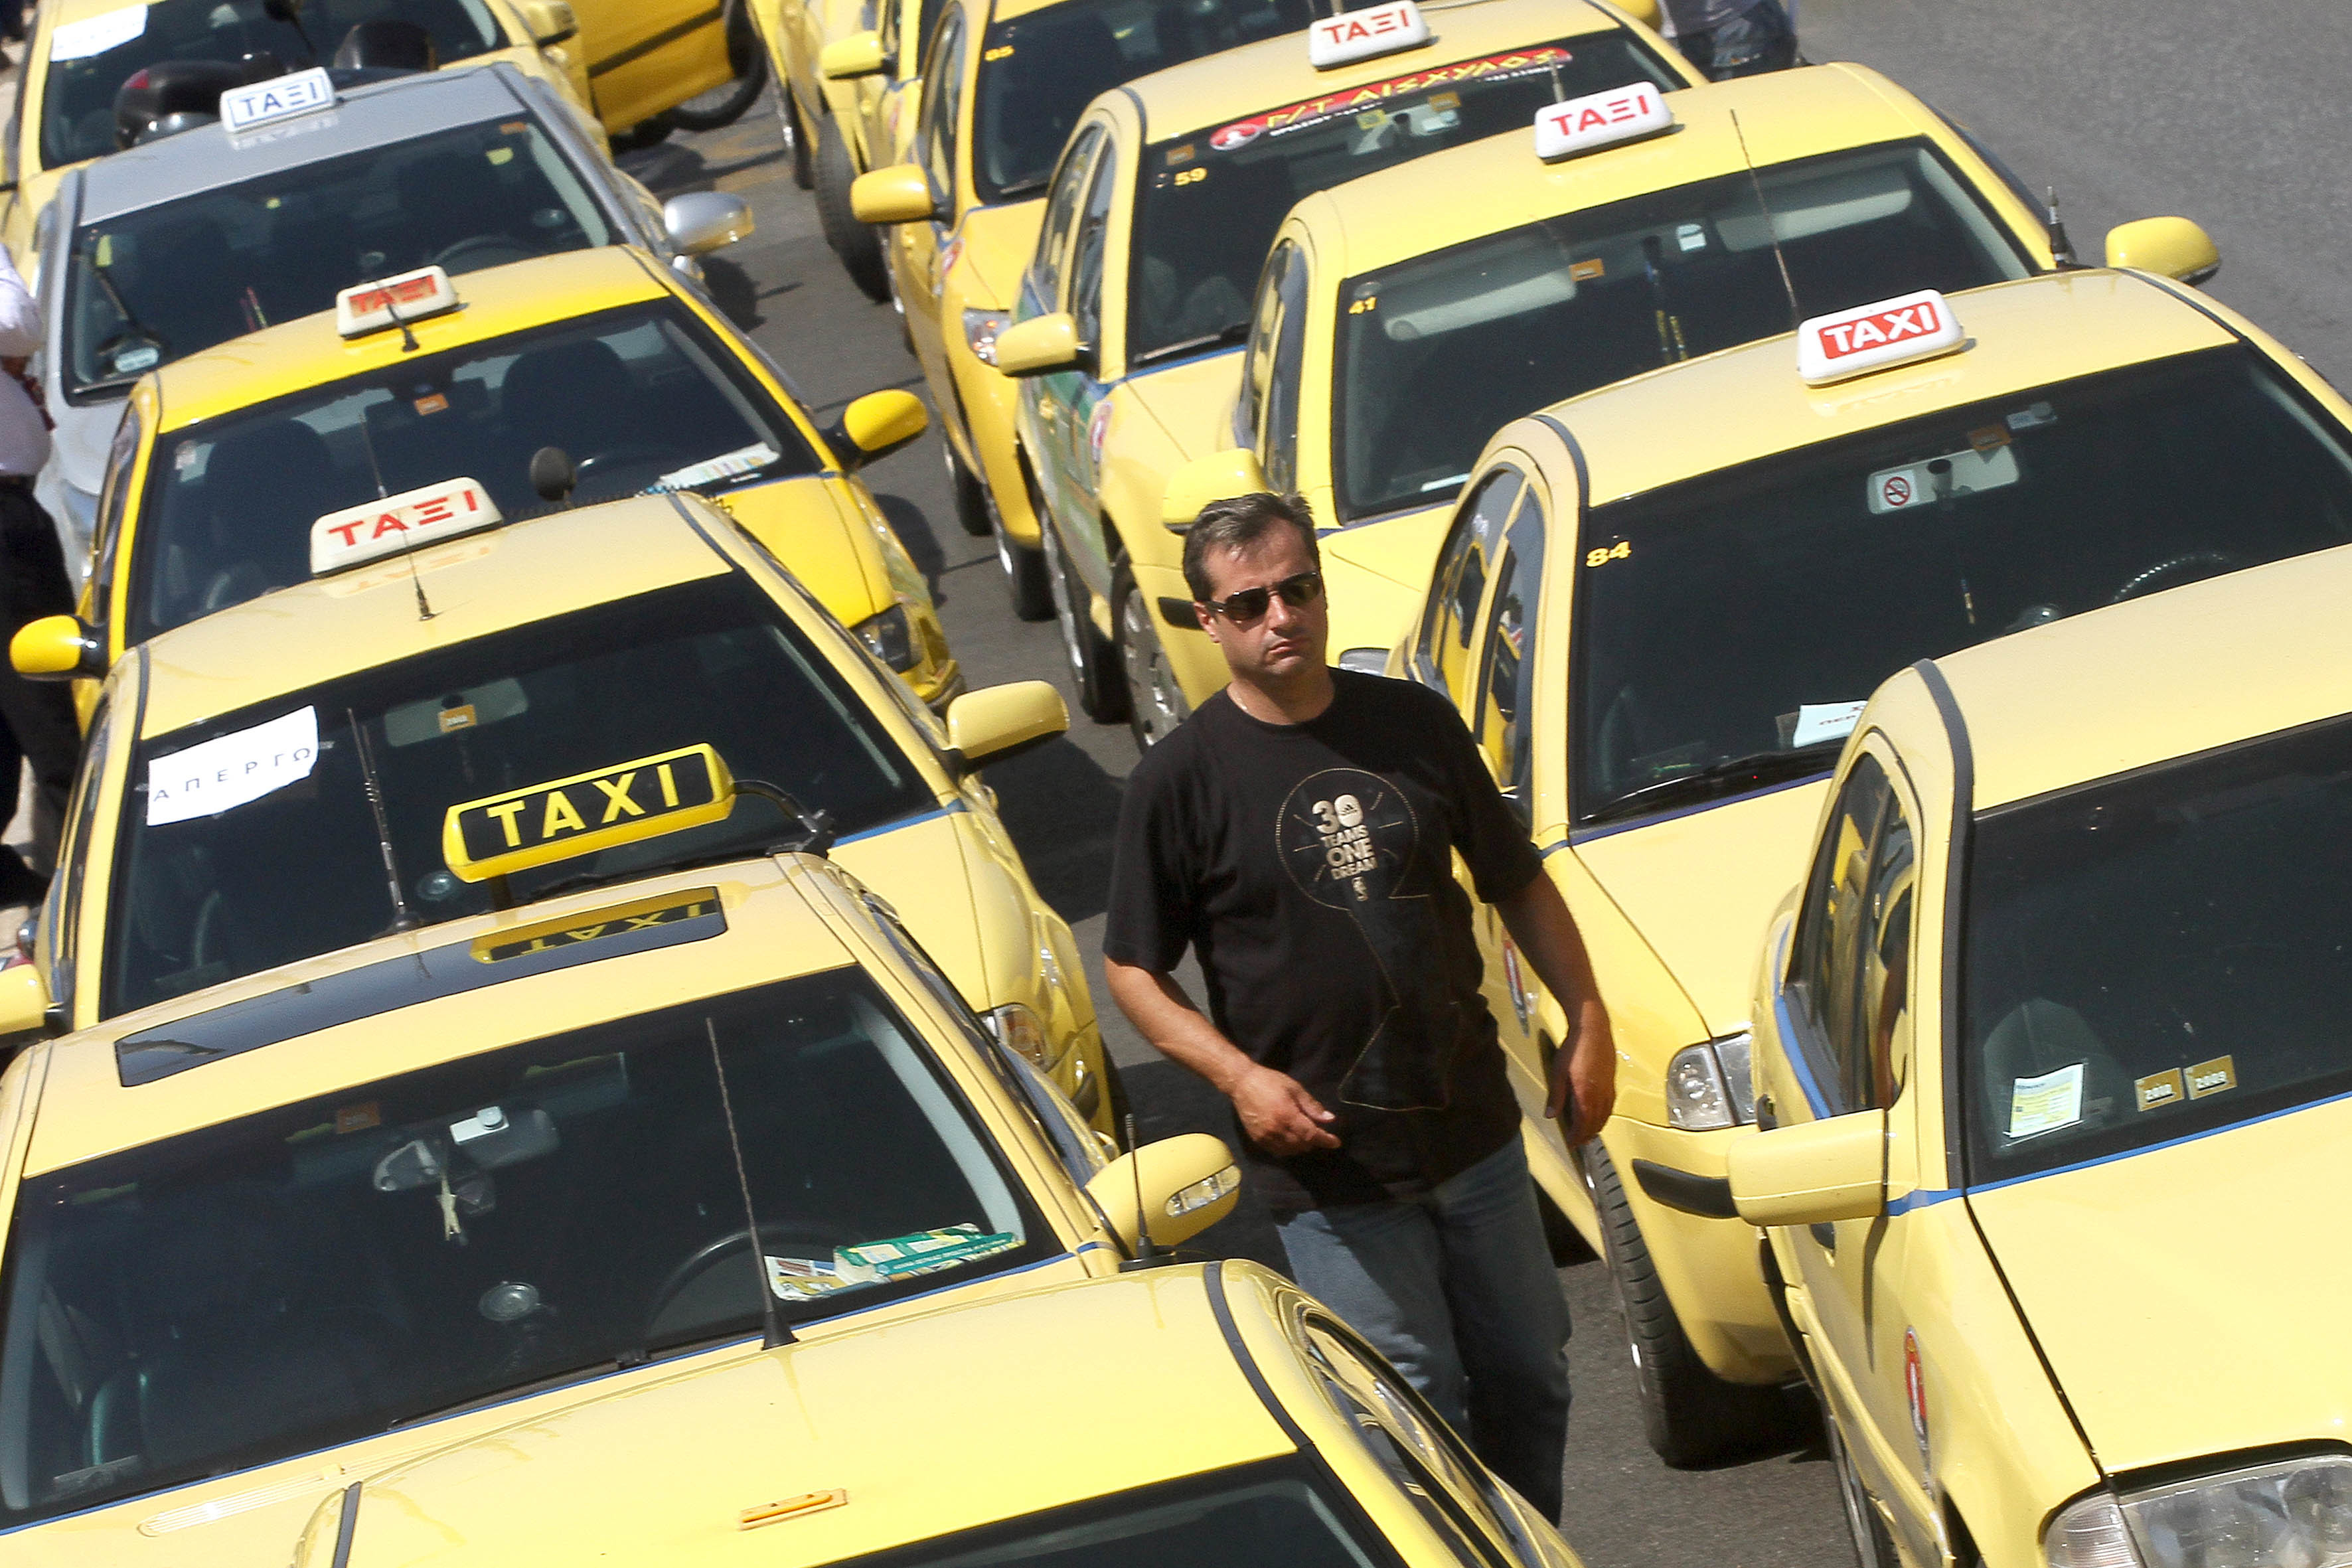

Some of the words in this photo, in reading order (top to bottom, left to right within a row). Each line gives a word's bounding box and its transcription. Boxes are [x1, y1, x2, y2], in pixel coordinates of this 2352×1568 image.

[1322, 9, 1410, 44] ΤΑΞΙ
[238, 82, 319, 117] ΤΑΞΙ
[1549, 95, 1650, 136] ΤΑΞΙ
[1174, 167, 1208, 186] 59
[349, 275, 437, 313] ΤΑΞΙ
[1348, 297, 1377, 314] 41
[1824, 305, 1935, 353] TAXI
[328, 489, 478, 546] ΤΑΞΙ
[1586, 541, 1632, 568] 84
[487, 763, 680, 848] TAXI
[1312, 794, 1364, 834] 30
[1320, 824, 1369, 848] TEAMS
[1326, 838, 1375, 867] ONE
[1330, 857, 1378, 880] DREAM
